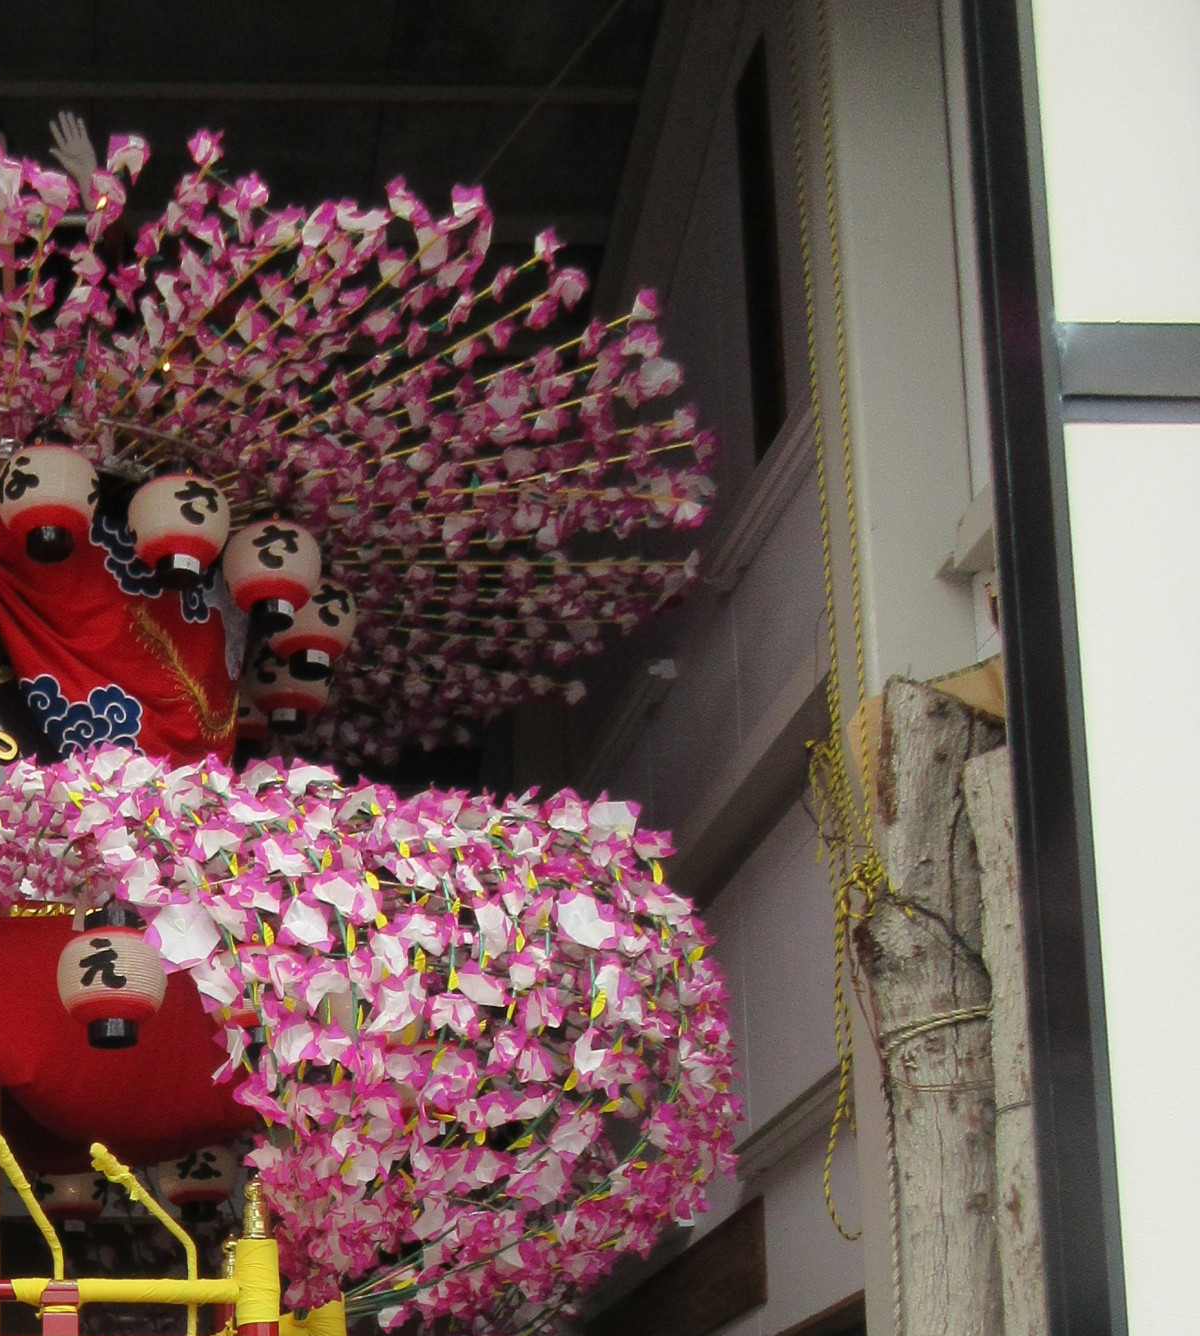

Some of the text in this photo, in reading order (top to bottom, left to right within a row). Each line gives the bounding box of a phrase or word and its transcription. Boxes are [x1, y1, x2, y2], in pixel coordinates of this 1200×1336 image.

[174, 480, 219, 525] さ
[252, 524, 299, 569] さ
[312, 582, 351, 627] さ
[79, 938, 127, 988] え
